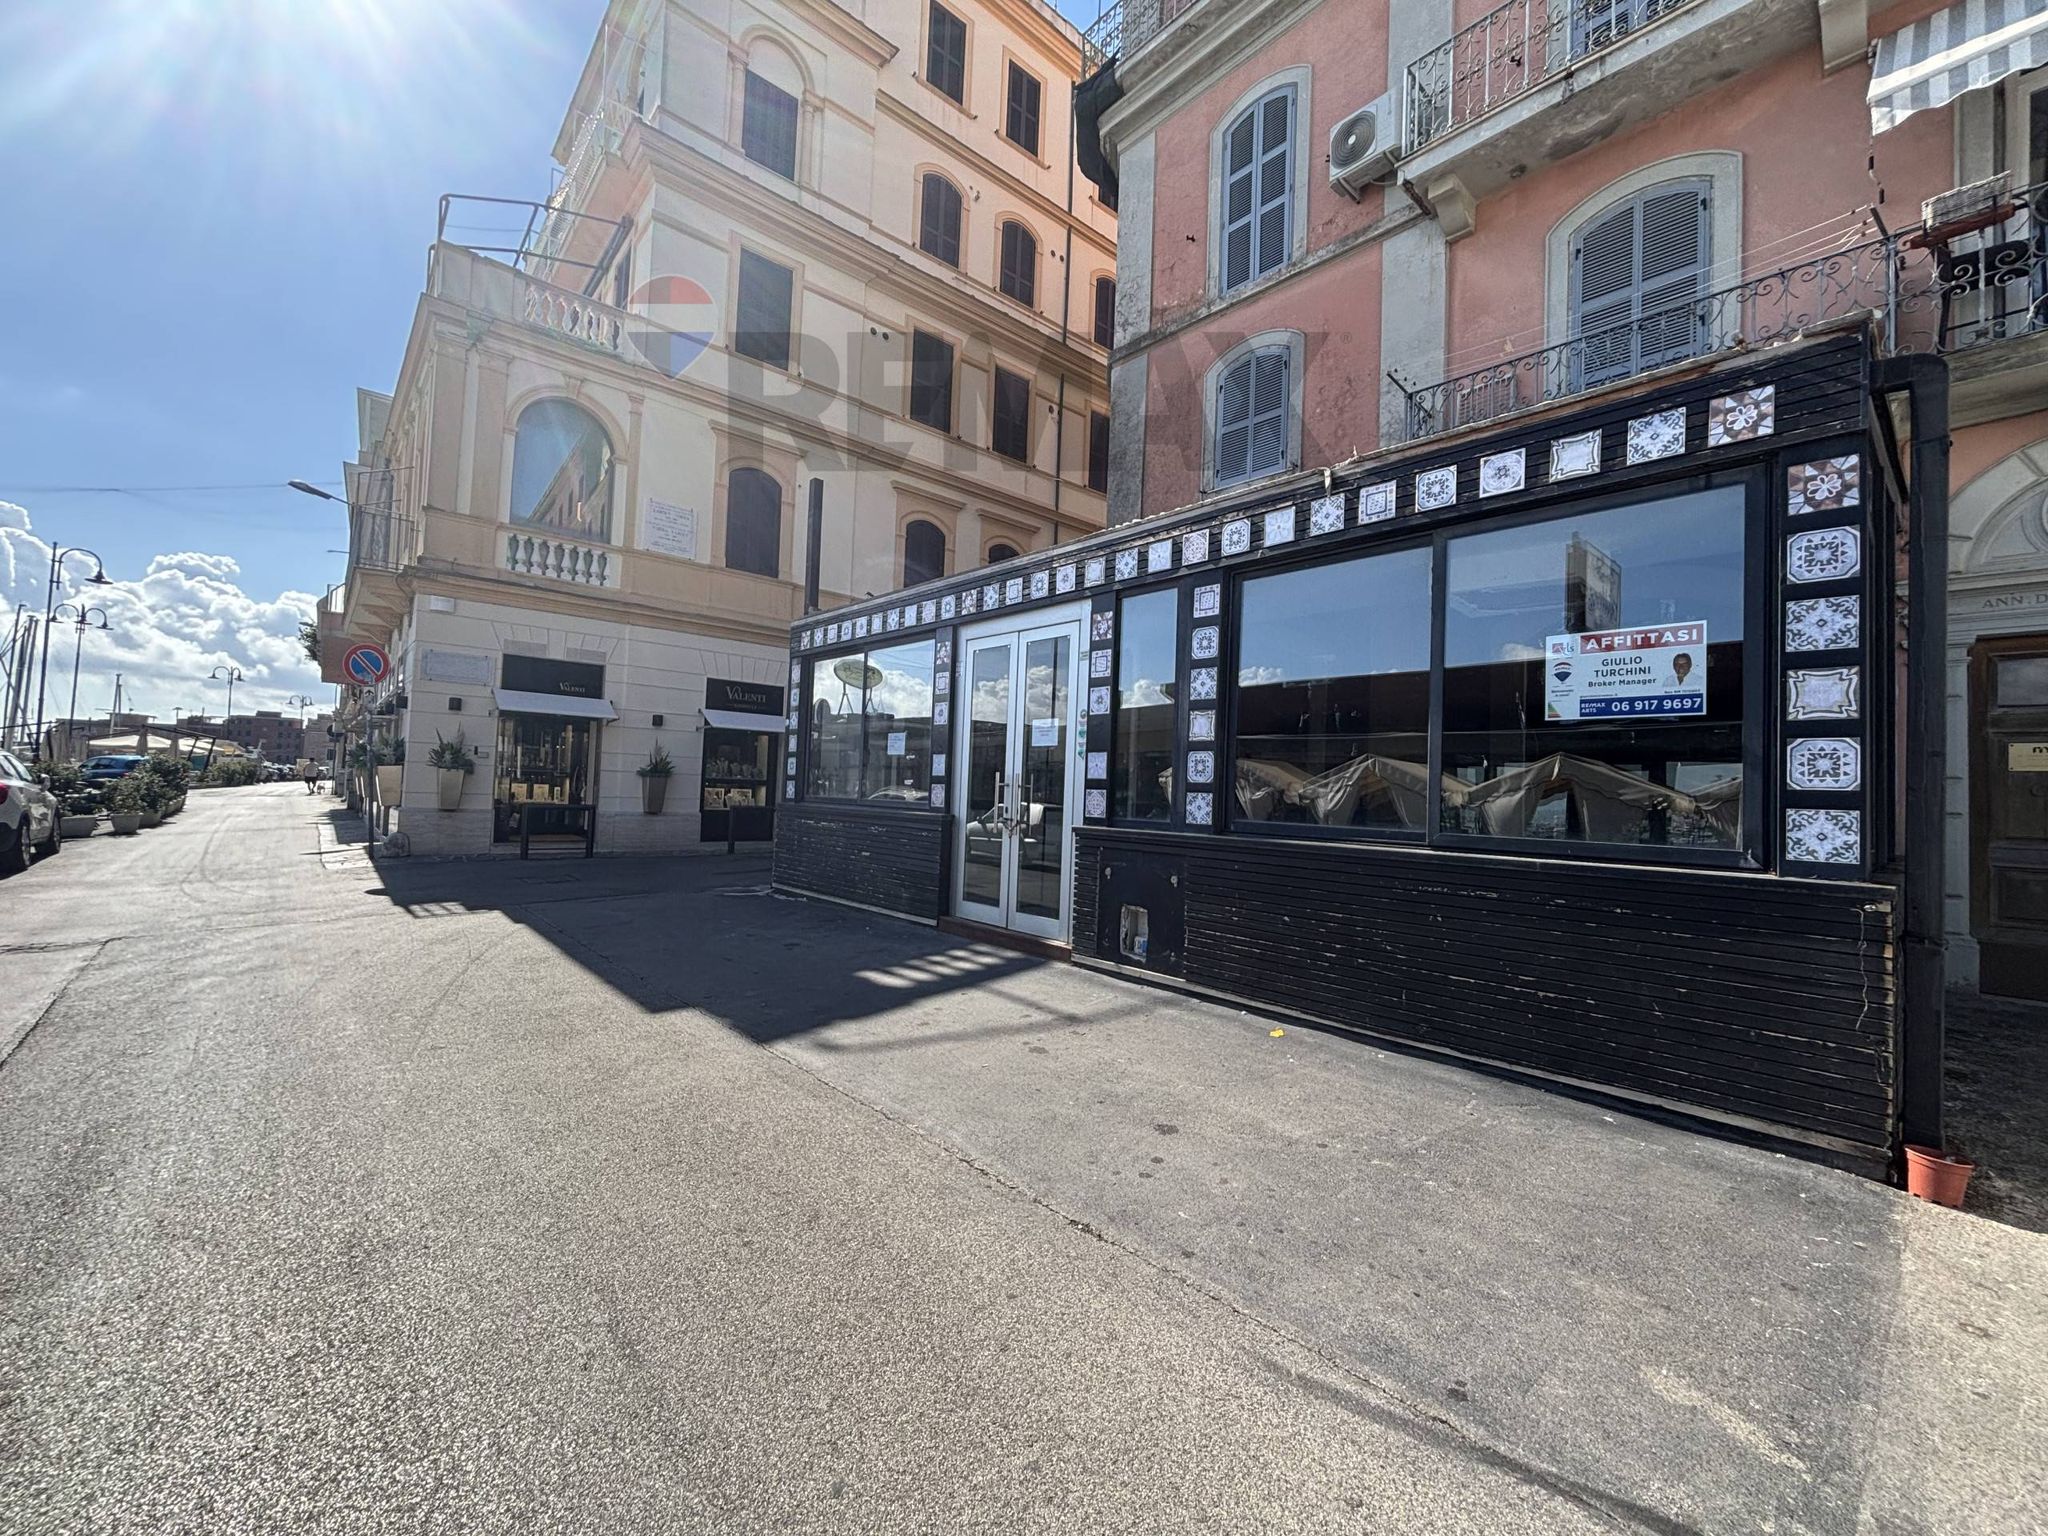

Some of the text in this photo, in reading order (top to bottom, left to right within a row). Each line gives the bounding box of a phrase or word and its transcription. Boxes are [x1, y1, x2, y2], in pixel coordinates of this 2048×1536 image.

[1586, 628, 1698, 650] AFFITTASI
[1601, 656, 1643, 667] GIULIO
[1594, 666, 1651, 678] TURCHINI
[1618, 678, 1657, 686] Manager
[1611, 701, 1630, 712] 06
[1634, 700, 1658, 711] 917
[1663, 698, 1702, 709] 9697
